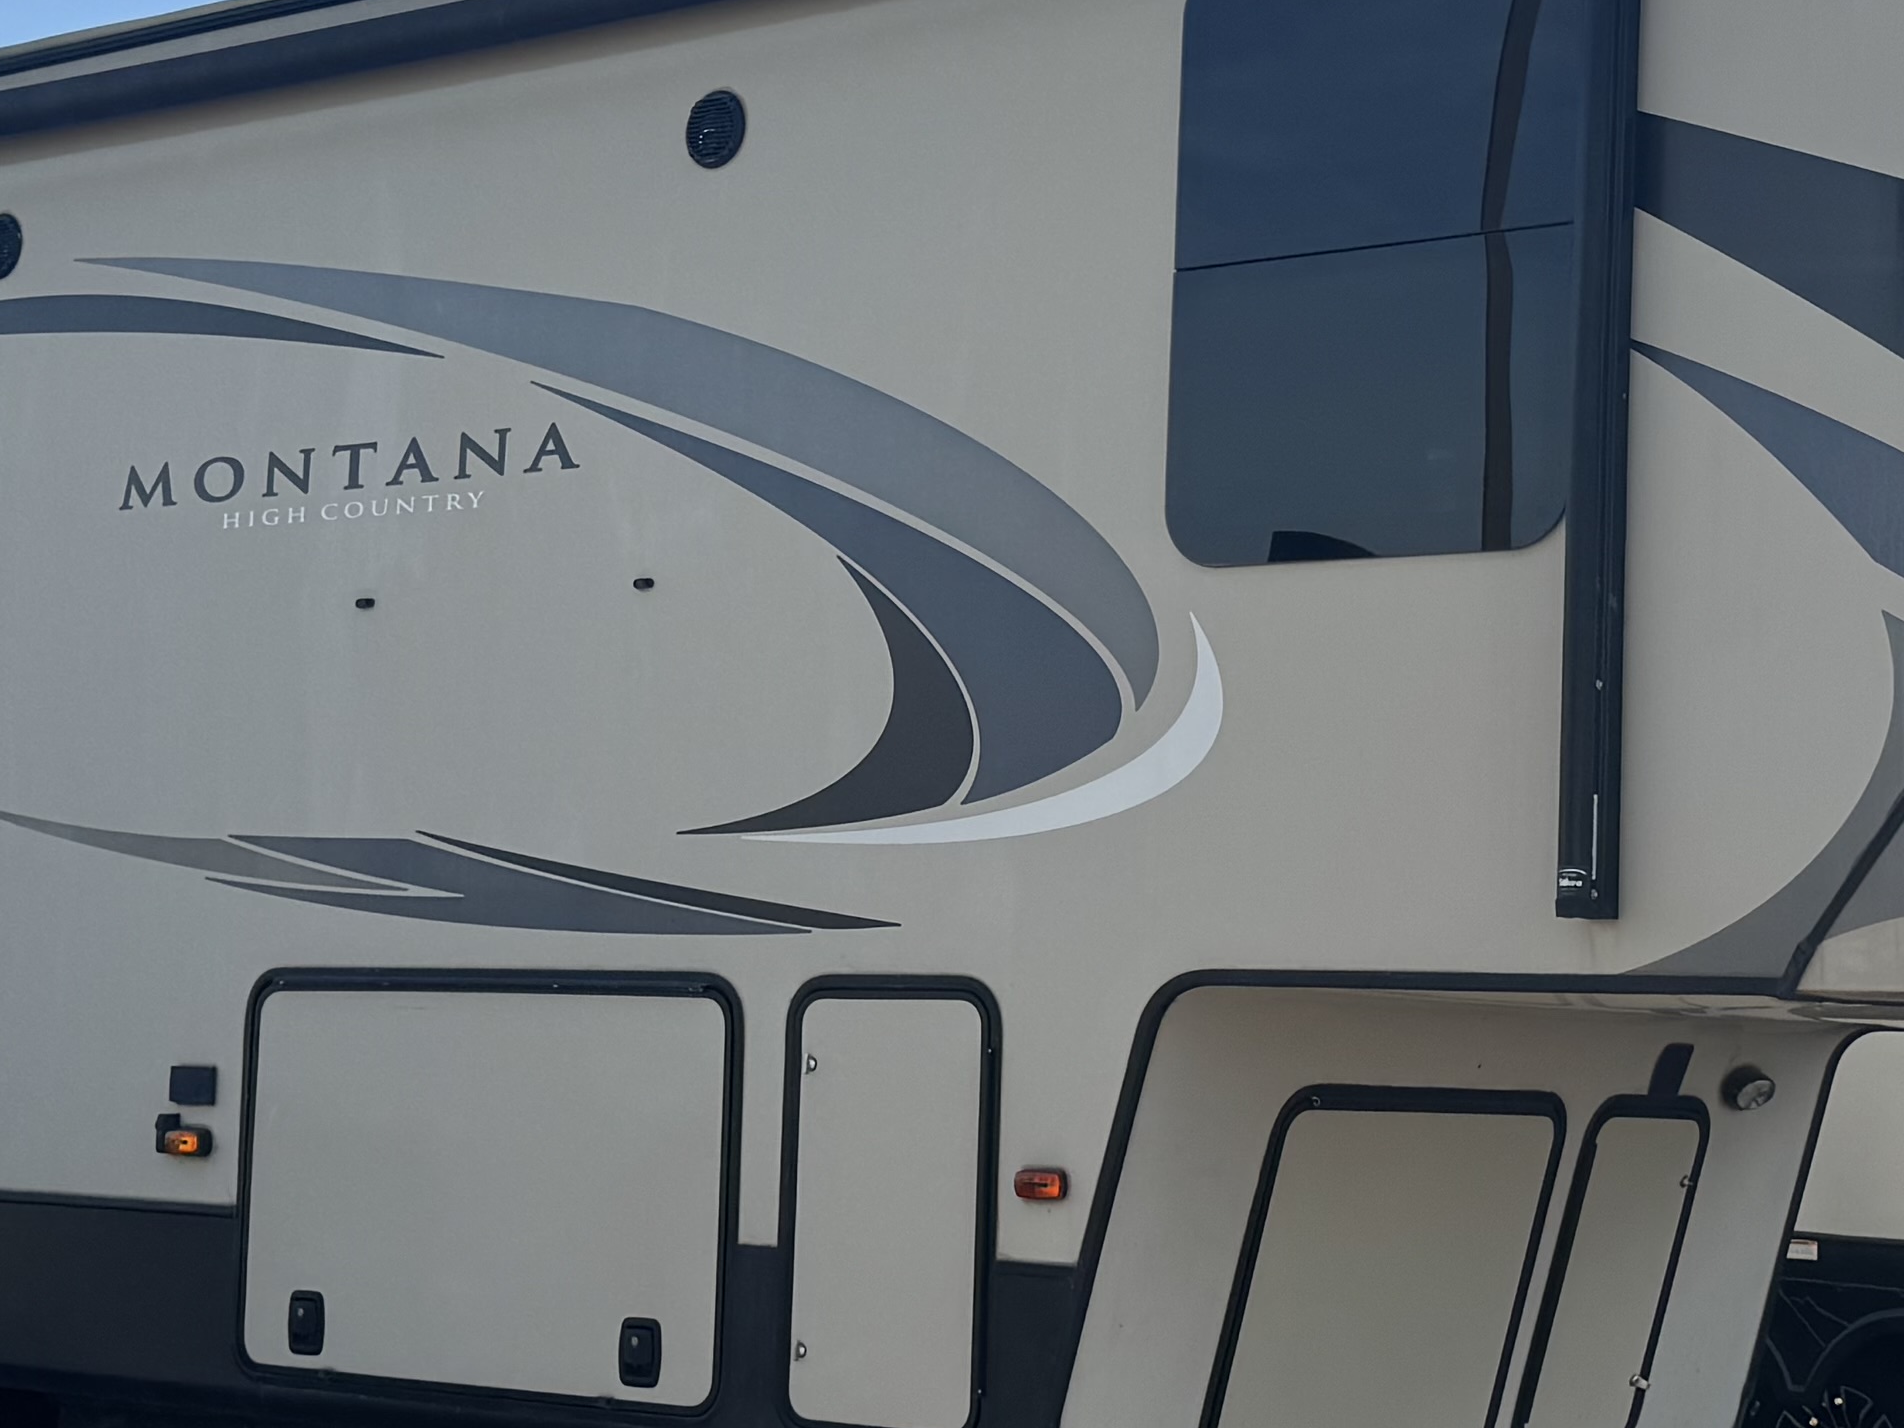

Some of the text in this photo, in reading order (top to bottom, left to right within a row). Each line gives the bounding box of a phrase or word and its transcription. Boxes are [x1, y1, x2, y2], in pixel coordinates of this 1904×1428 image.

[118, 421, 580, 511] MONTANA
[221, 489, 487, 529] HIGH COUNTRY
